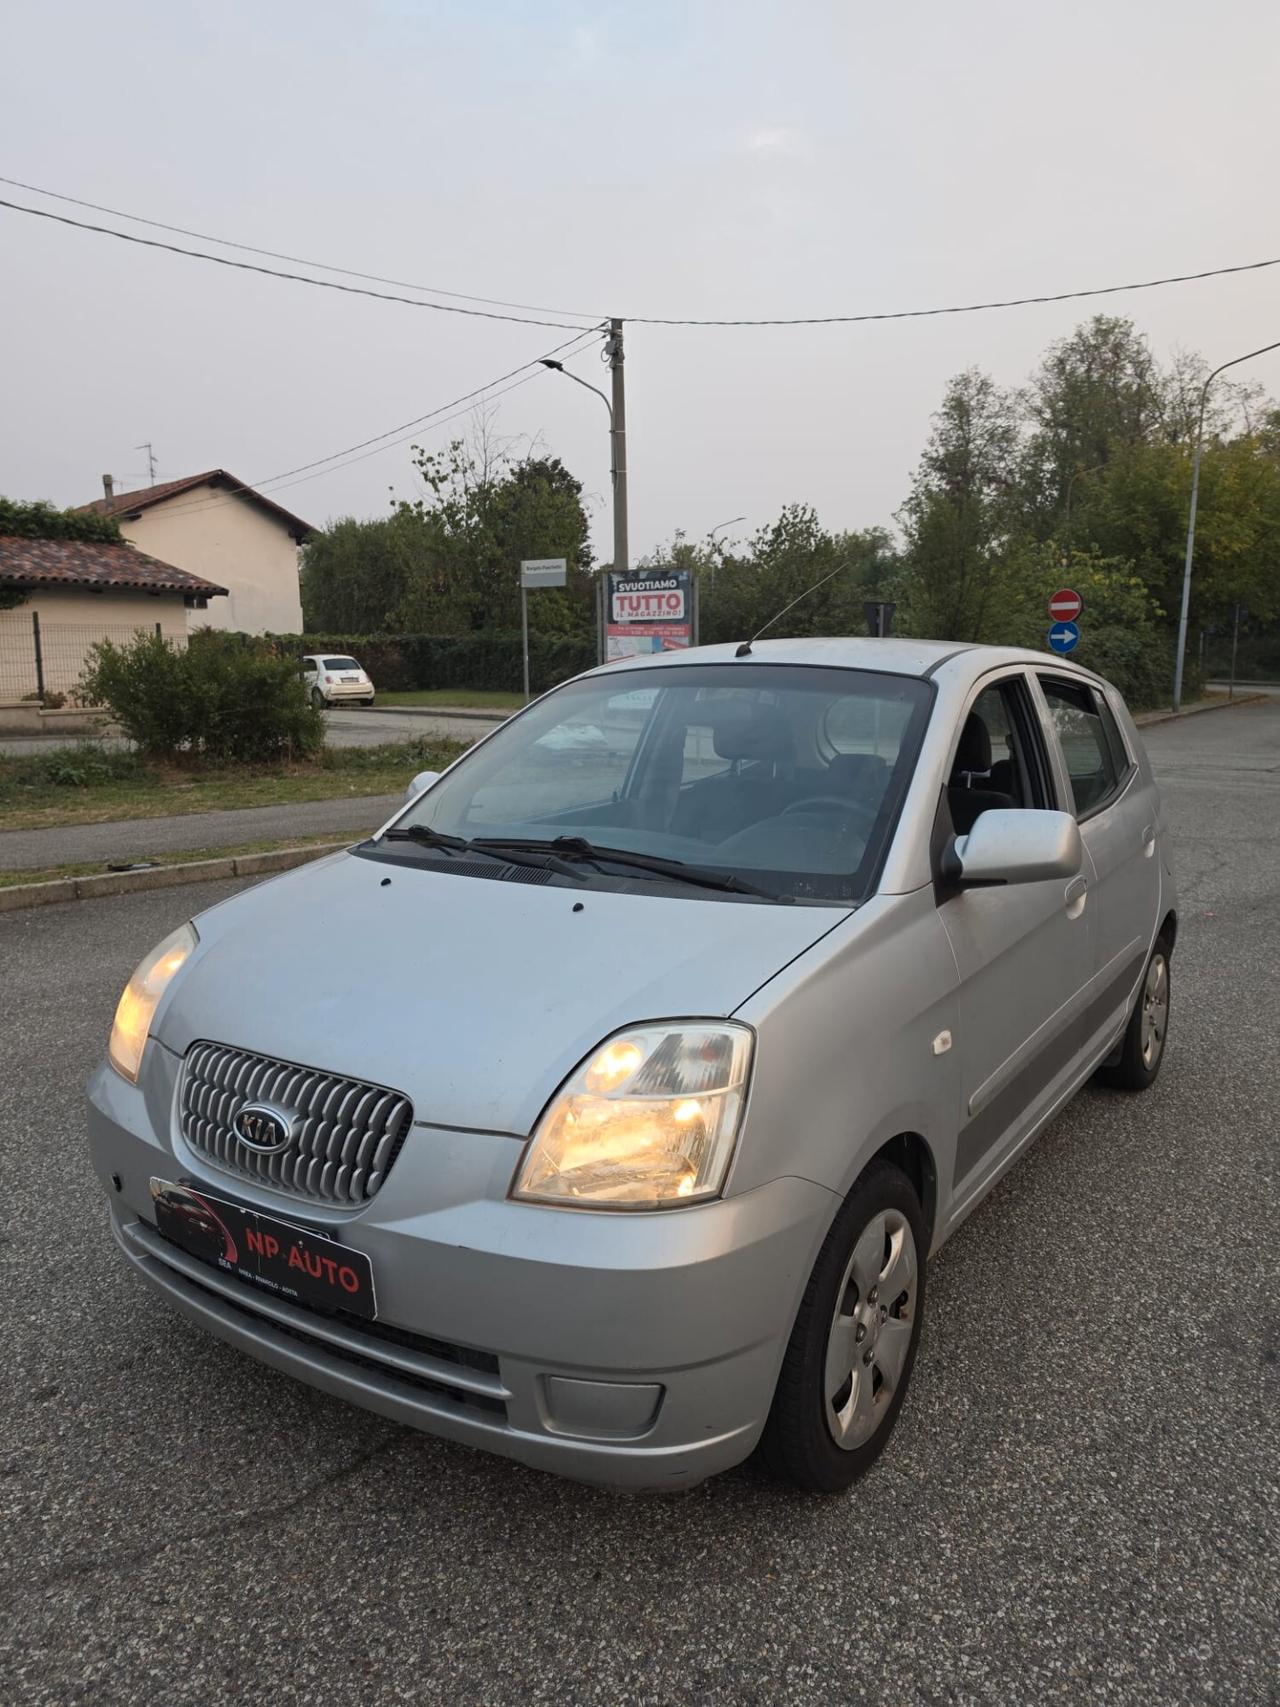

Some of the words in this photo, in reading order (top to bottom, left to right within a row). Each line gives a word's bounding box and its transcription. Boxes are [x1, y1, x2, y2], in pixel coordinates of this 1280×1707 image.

[619, 579, 677, 592] SVUOTIAMO
[616, 593, 682, 612] TUTTO
[241, 1114, 277, 1146] KIA
[287, 1245, 360, 1294] AUTO
